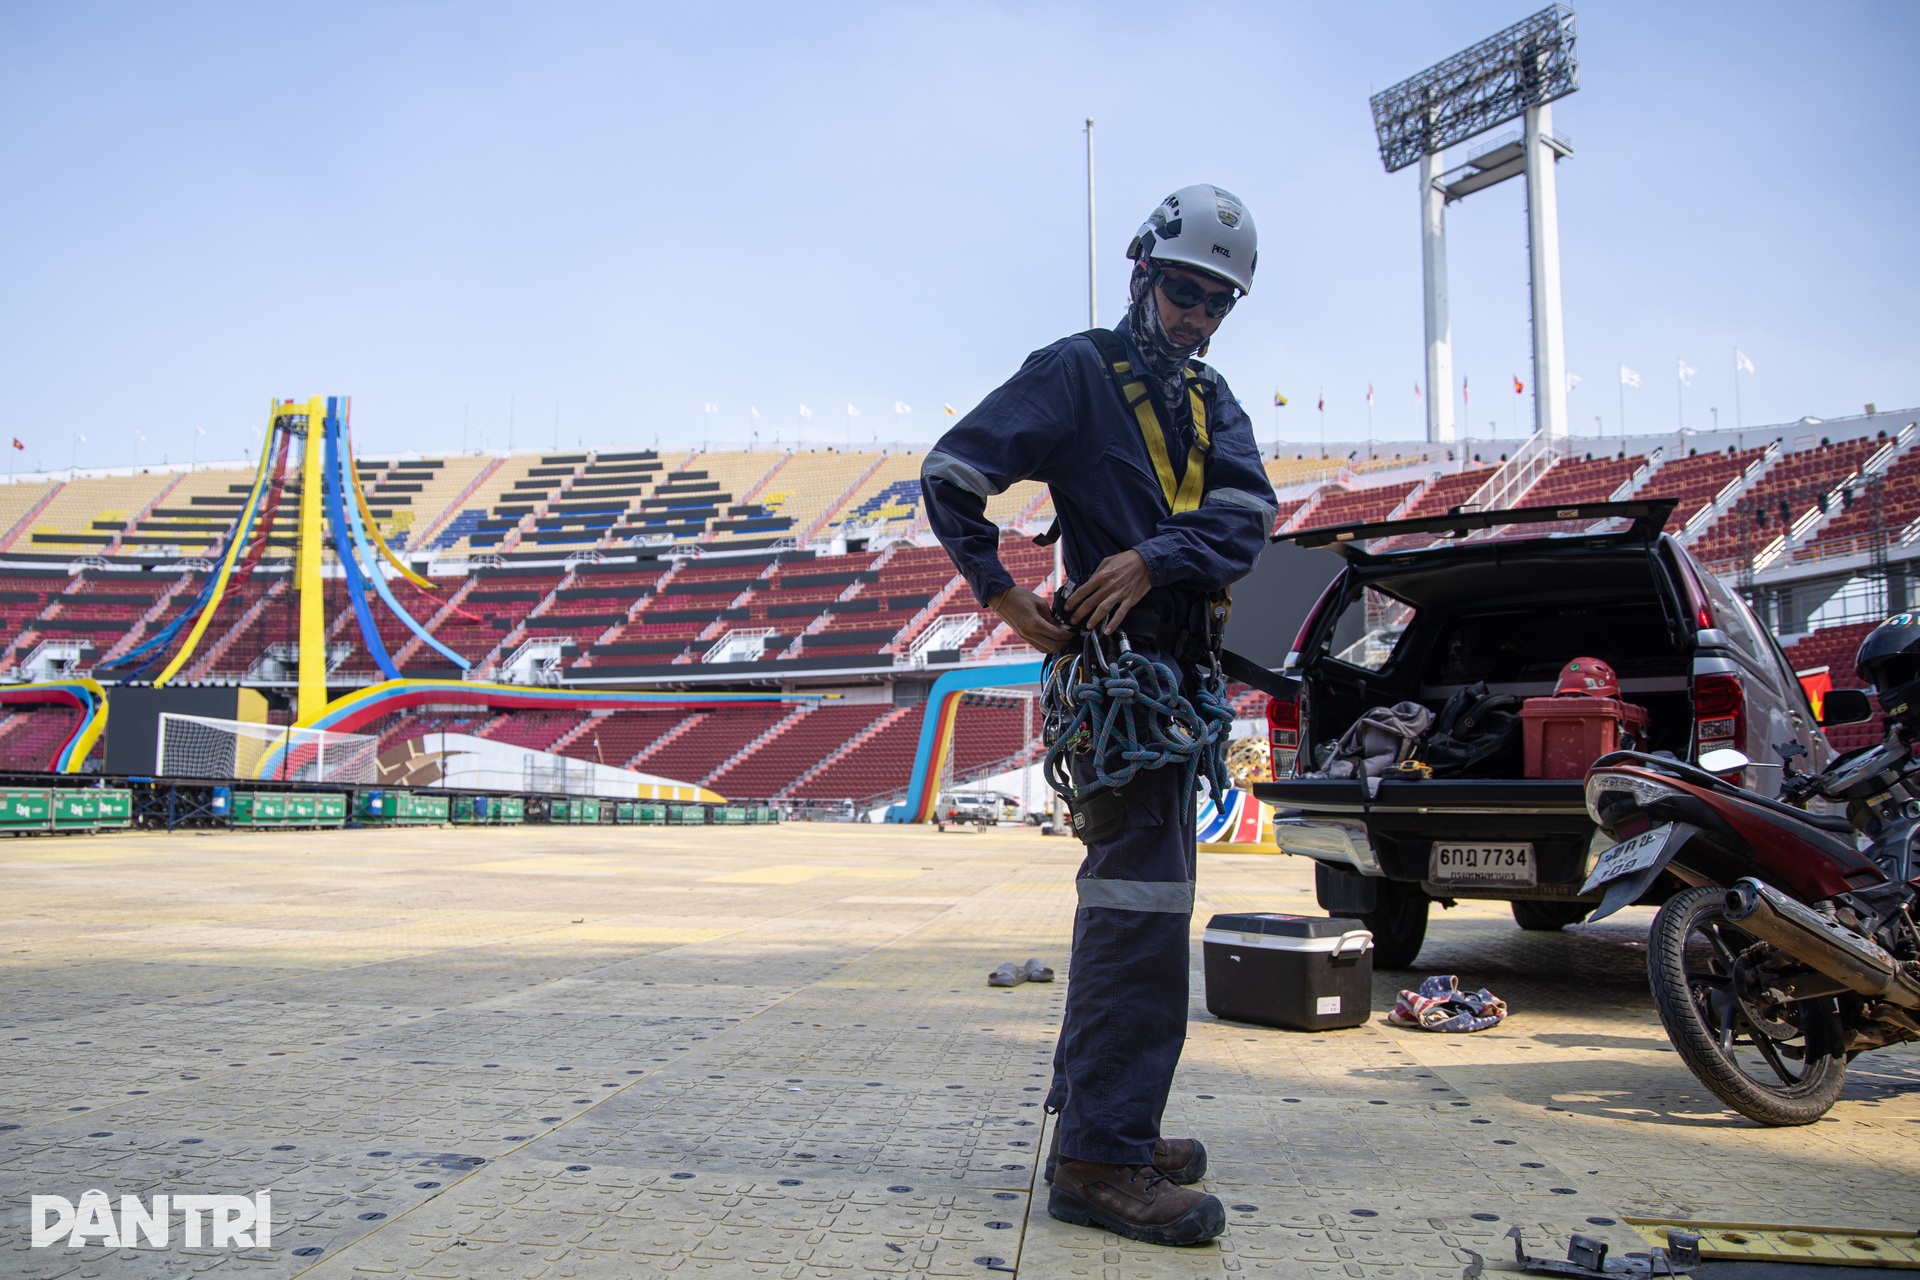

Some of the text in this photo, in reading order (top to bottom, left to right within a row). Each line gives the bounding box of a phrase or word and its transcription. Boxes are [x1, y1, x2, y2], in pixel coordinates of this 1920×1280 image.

[1212, 244, 1231, 258] PETZL
[1482, 849, 1527, 866] 7734
[1450, 871, 1516, 880] กรงเทพมหานคร
